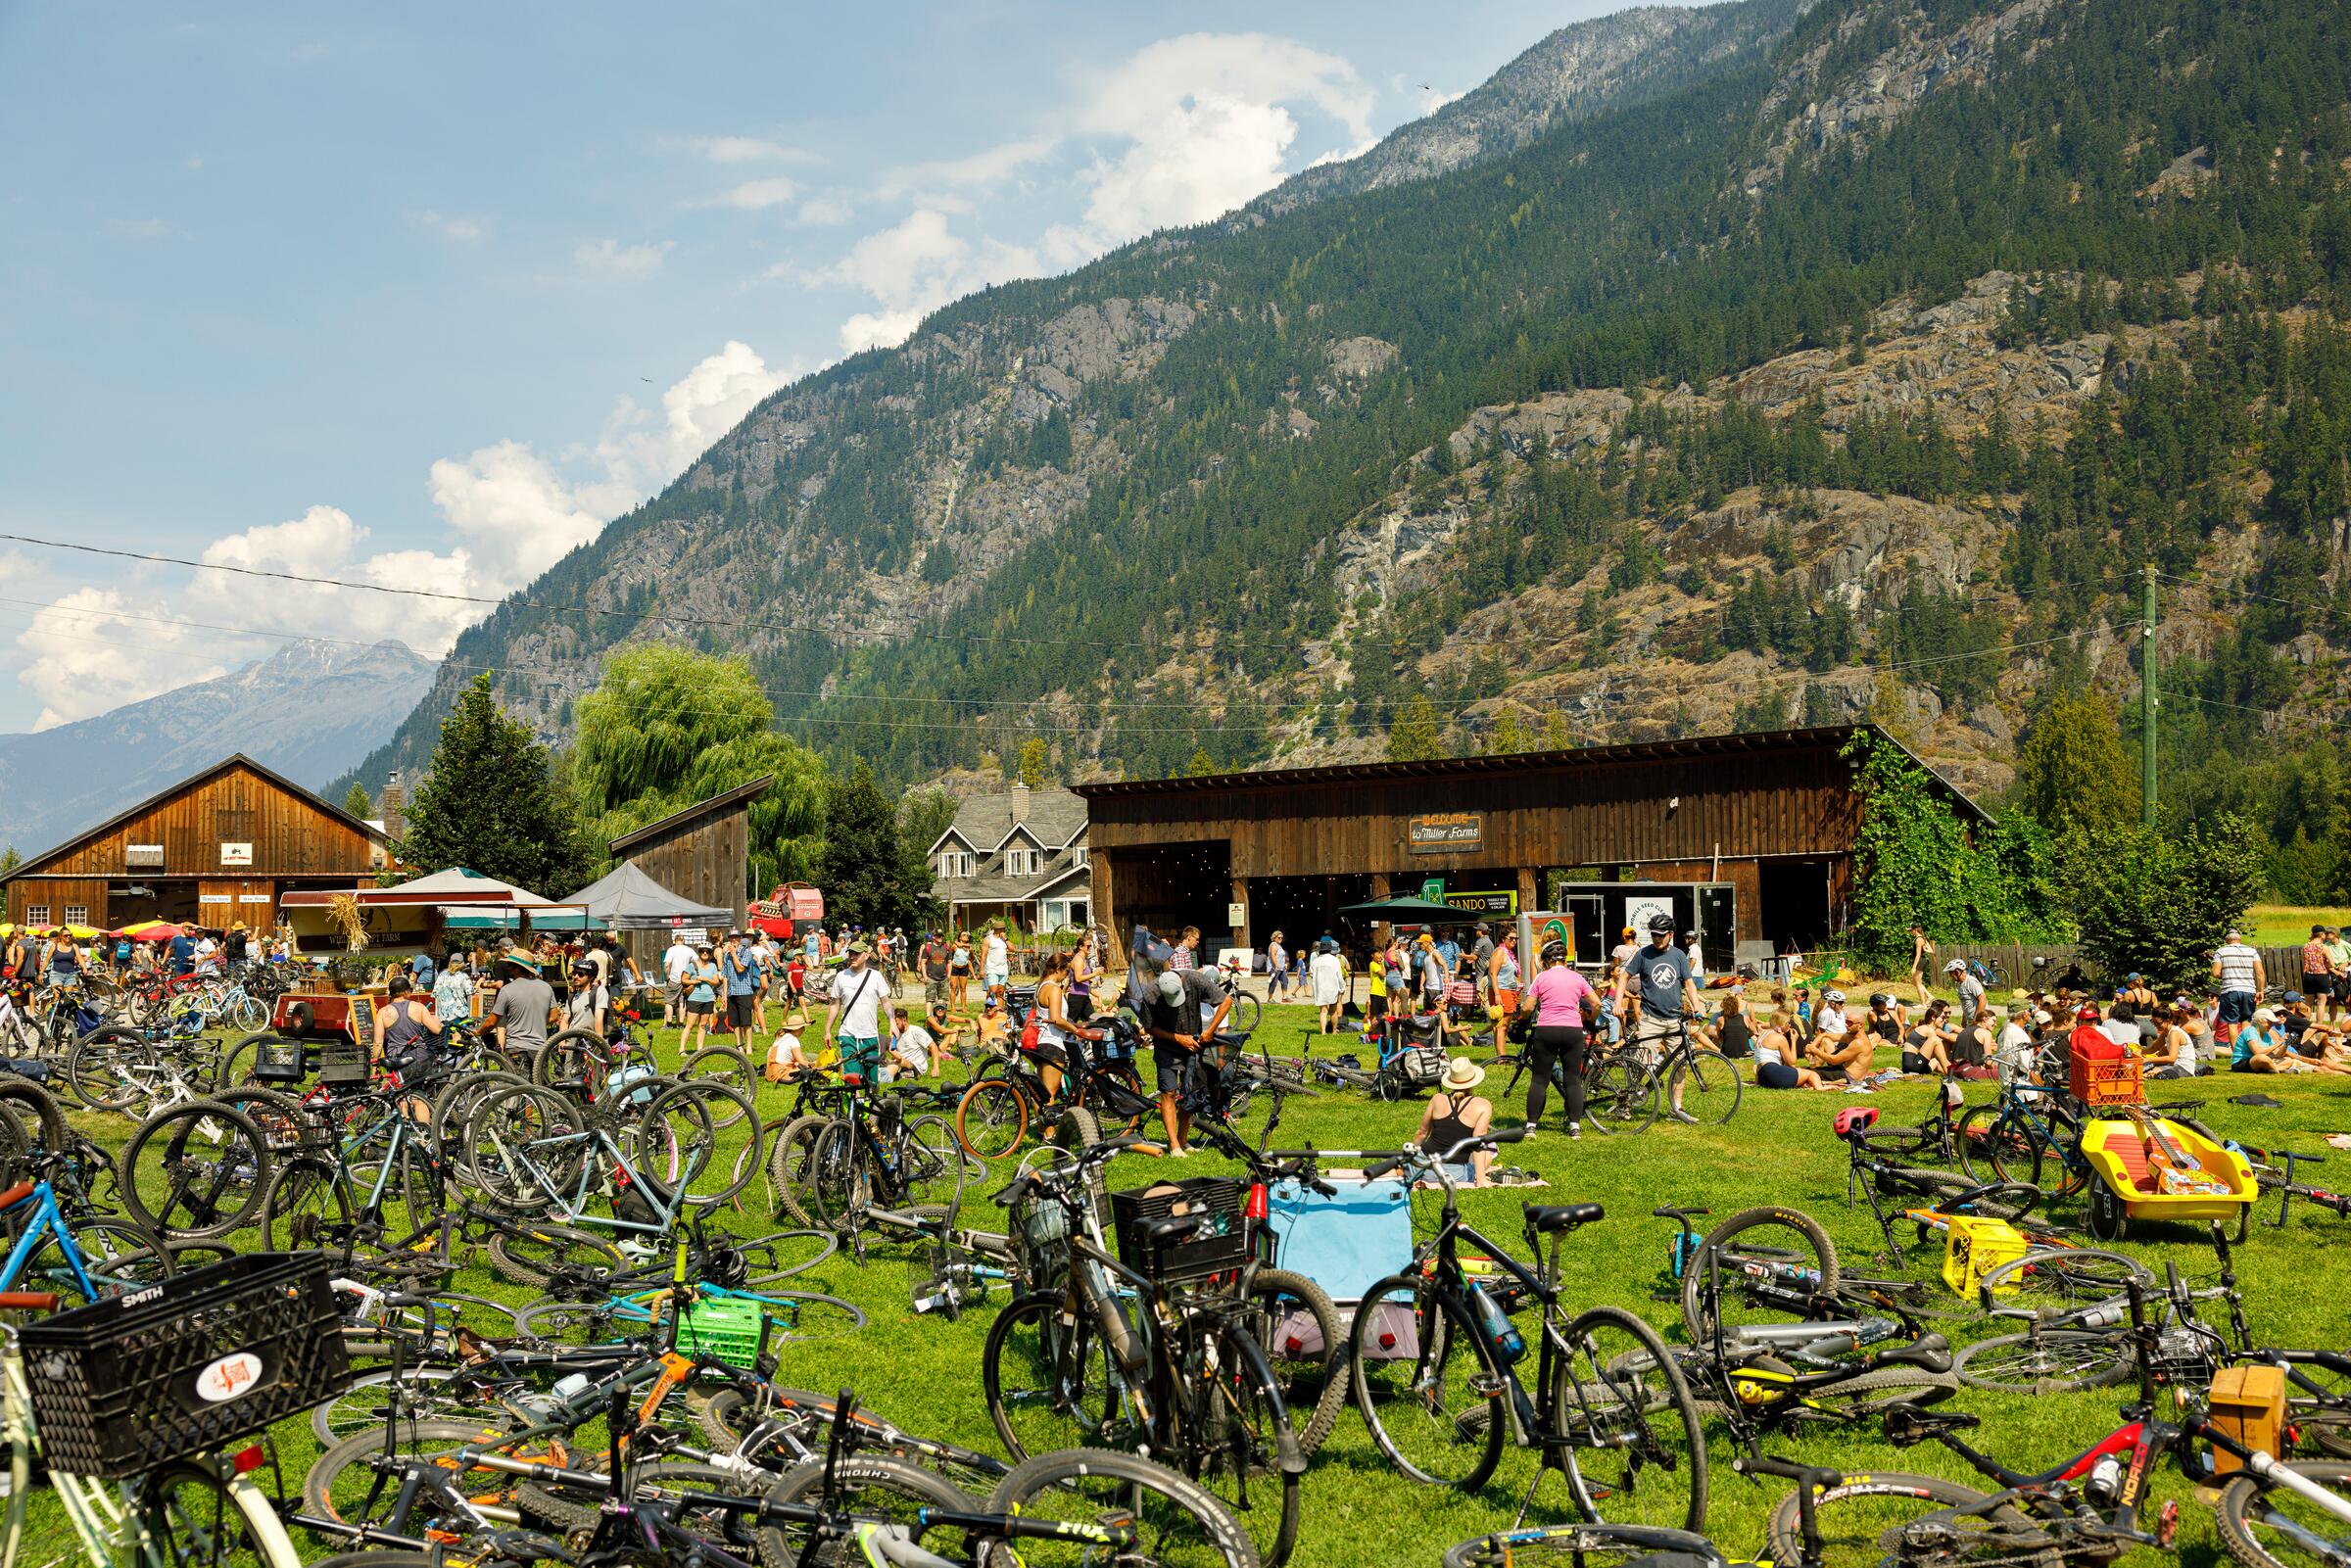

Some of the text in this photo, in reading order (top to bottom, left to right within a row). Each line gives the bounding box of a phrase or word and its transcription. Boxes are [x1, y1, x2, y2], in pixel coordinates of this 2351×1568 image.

[1422, 814, 1467, 826] WELCOME
[1412, 827, 1479, 839] to Miller Farms
[1448, 898, 1486, 910] SANDO
[1629, 906, 1641, 926] MOBILE
[381, 932, 401, 942] FARM
[1774, 1212, 1807, 1229] MAXXIS
[121, 1285, 164, 1308] SMITH
[834, 1470, 890, 1480] CHROMA
[2120, 1442, 2149, 1507] NORCO
